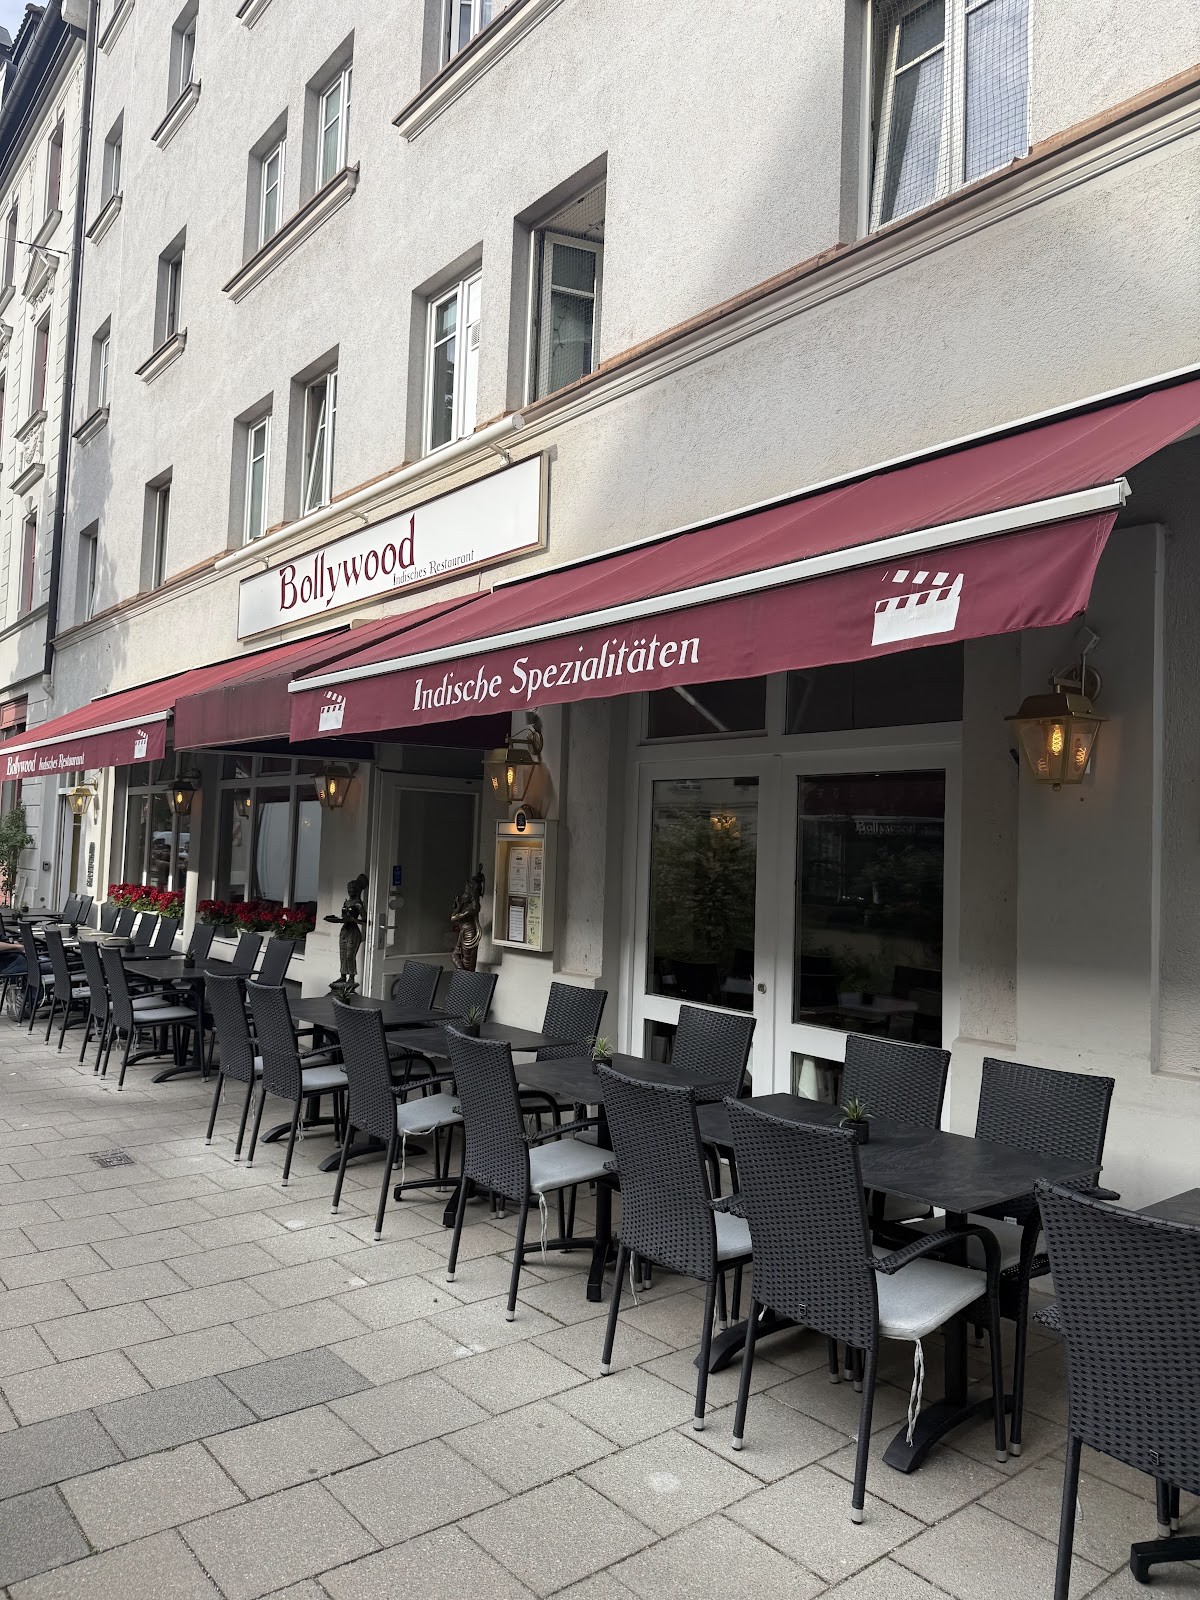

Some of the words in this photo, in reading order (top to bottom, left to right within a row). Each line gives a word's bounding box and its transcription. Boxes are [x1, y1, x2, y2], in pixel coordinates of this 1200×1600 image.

[279, 512, 416, 612] Bollywood
[393, 566, 427, 586] Indisches
[429, 548, 474, 576] Restaurant
[412, 665, 502, 711] Indische
[509, 634, 700, 701] Spezialitäten
[6, 752, 37, 778] Bollywood
